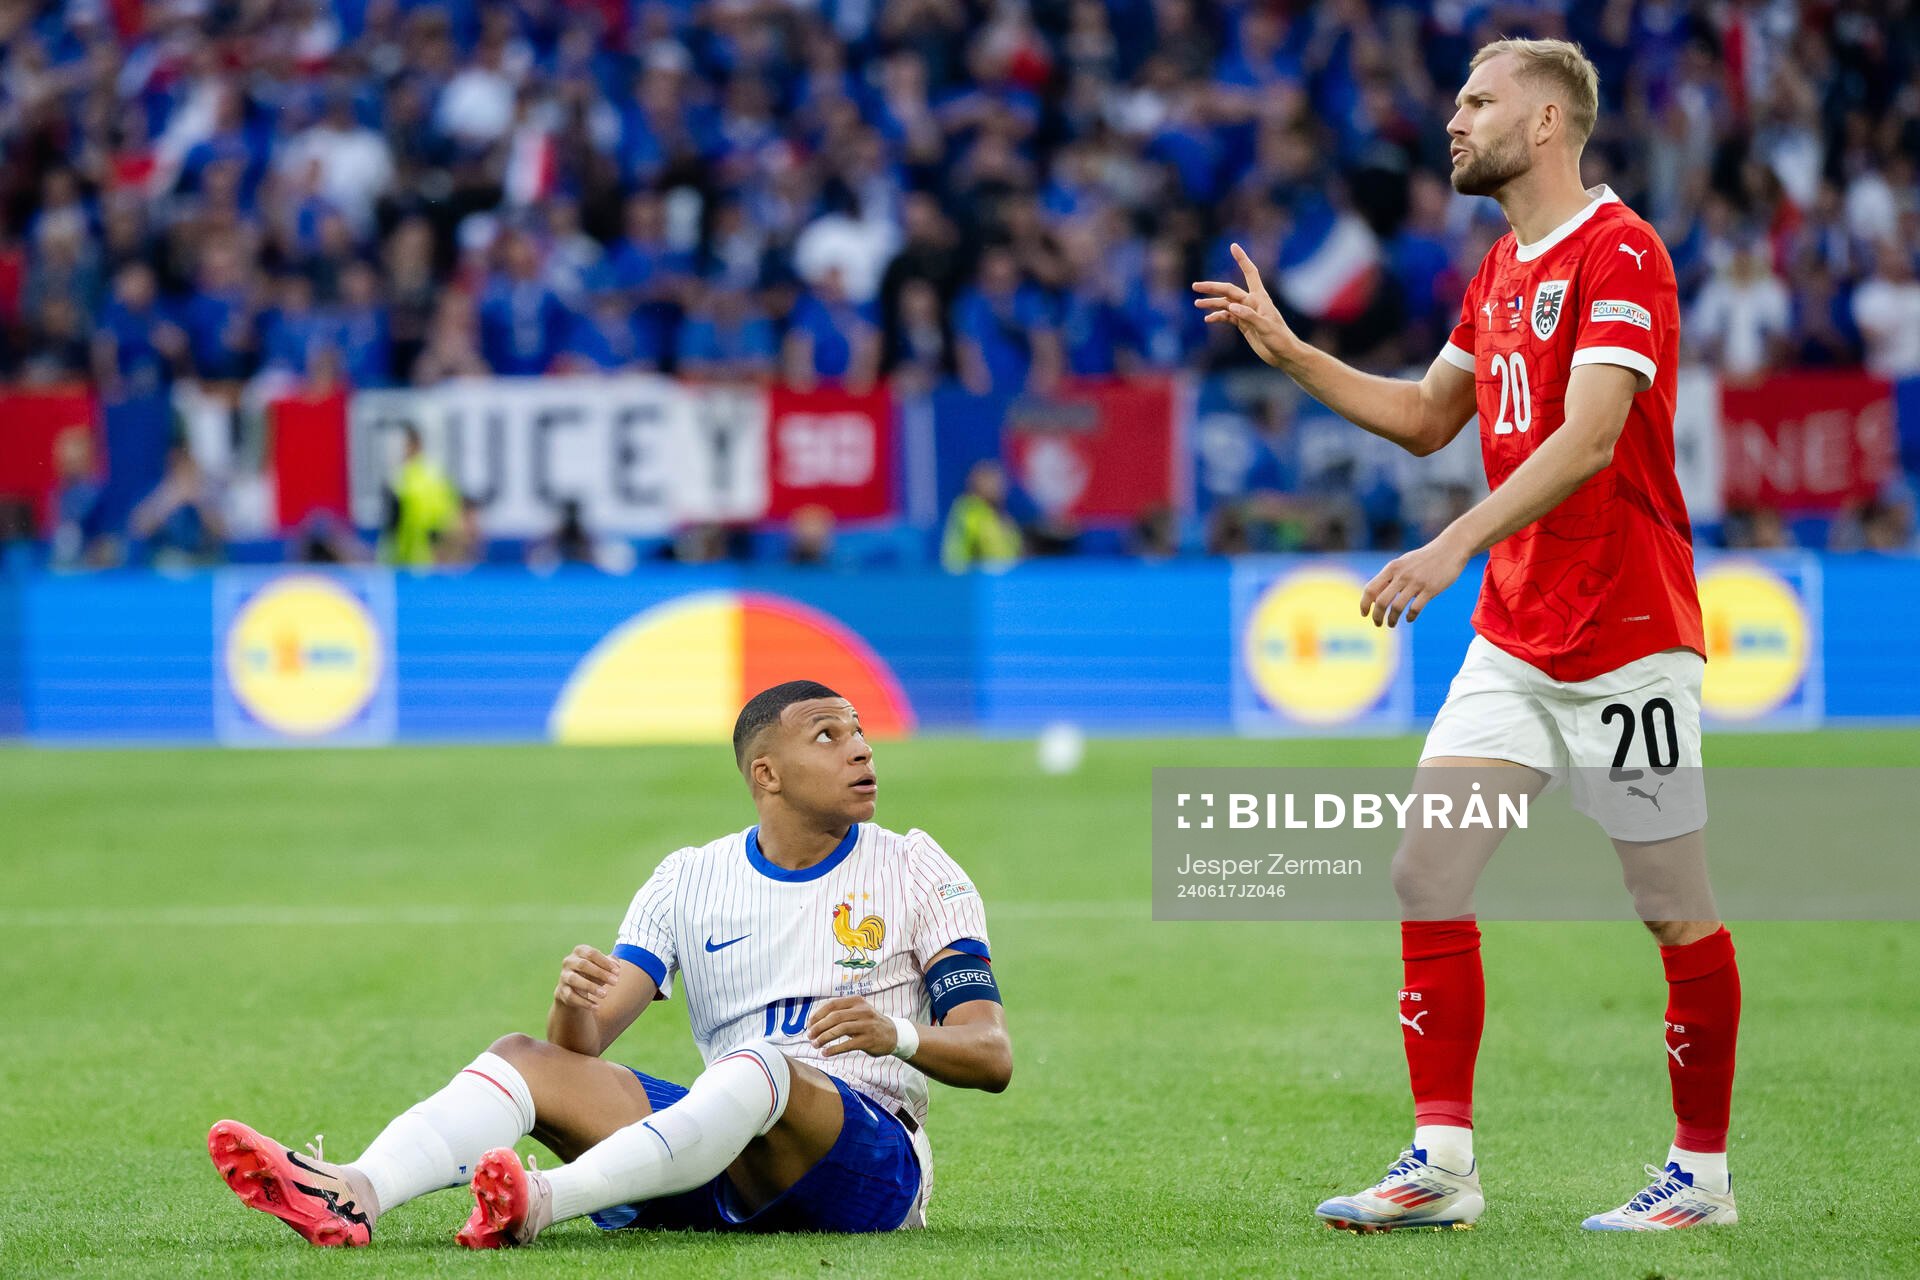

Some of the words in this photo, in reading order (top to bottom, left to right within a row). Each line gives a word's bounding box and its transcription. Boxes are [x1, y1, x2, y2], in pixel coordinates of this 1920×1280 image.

[1593, 306, 1650, 323] FOUNDATION
[1491, 351, 1532, 434] 20
[1600, 697, 1680, 782] 20
[944, 972, 992, 988] RESPECT
[1398, 990, 1422, 1001] FB
[1664, 1021, 1685, 1033] FB
